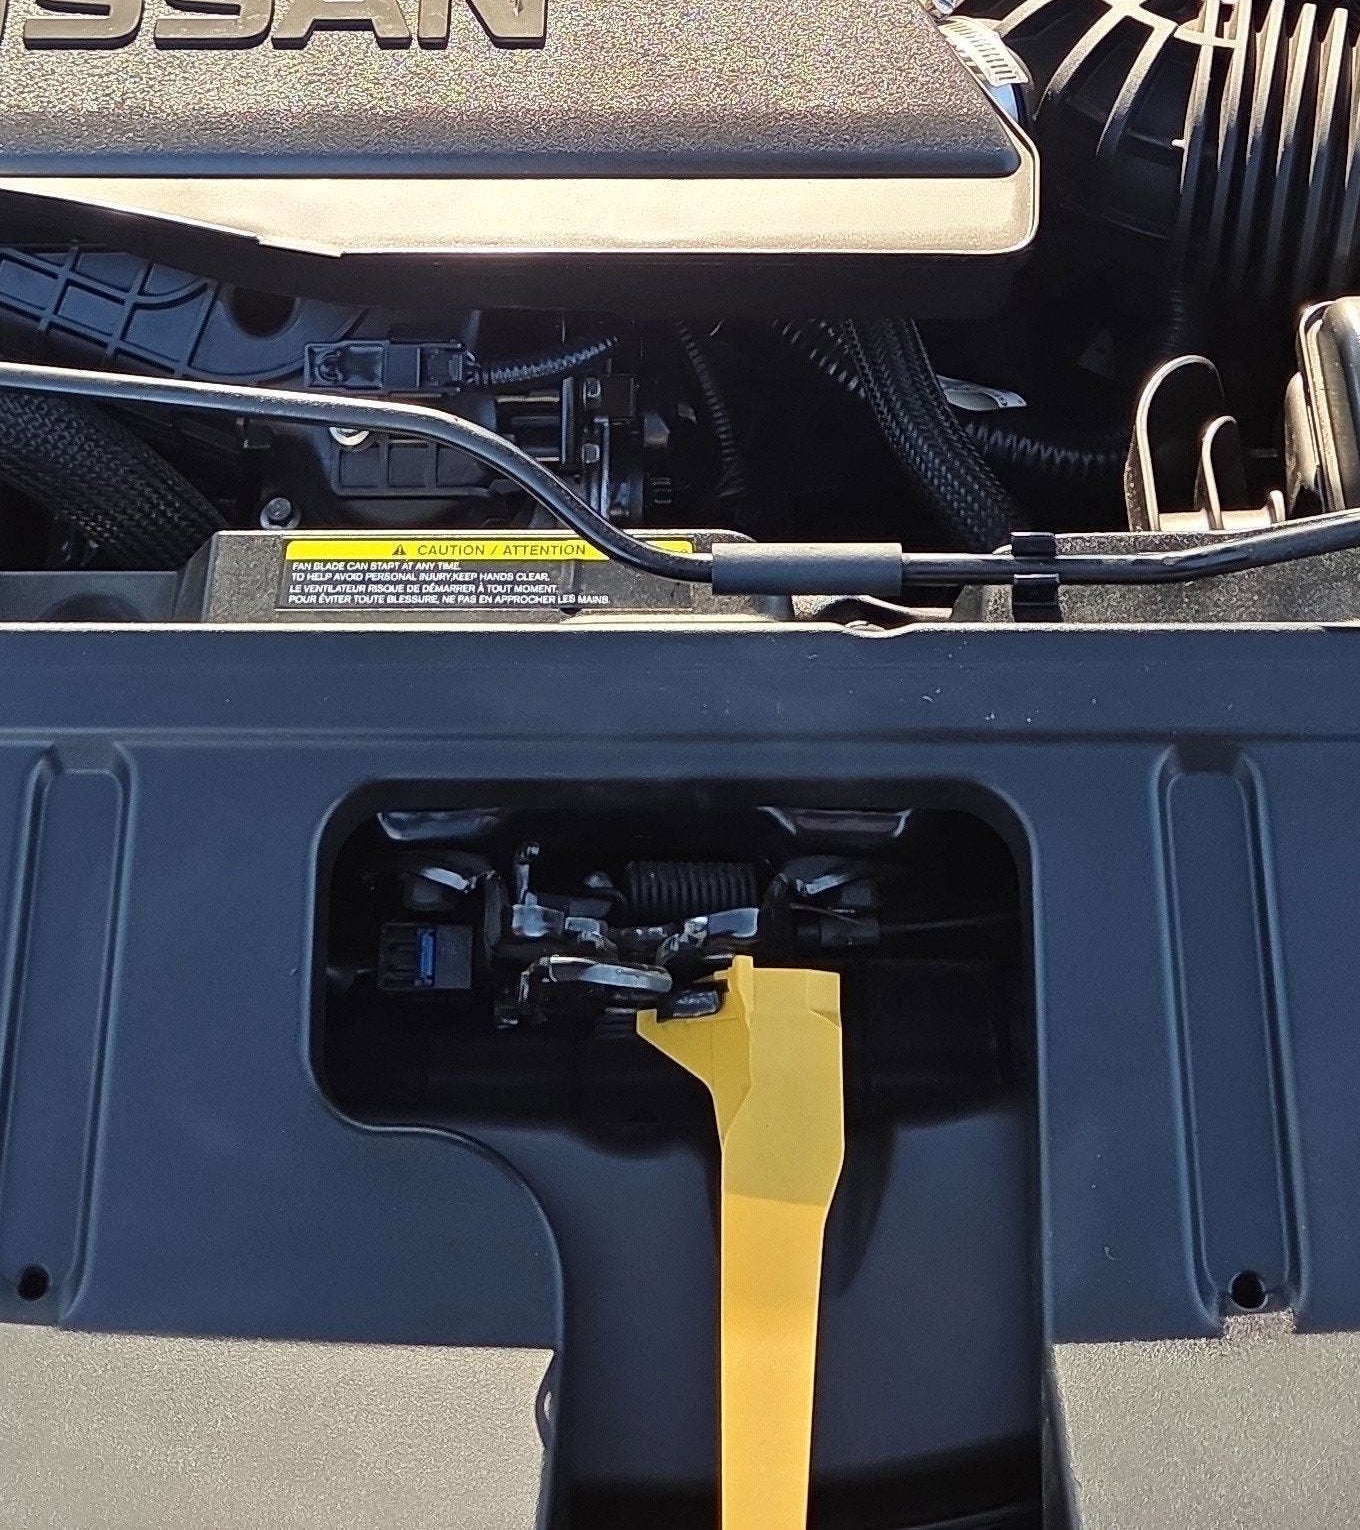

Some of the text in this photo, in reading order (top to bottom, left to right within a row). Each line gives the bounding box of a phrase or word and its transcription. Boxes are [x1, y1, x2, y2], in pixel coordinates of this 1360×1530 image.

[417, 544, 485, 556] CAUTION
[502, 544, 587, 556] ATTENTION
[292, 561, 311, 570] FAN
[313, 561, 345, 570] BLADE
[347, 561, 369, 570] CAN
[370, 561, 400, 570] START
[401, 561, 413, 570] AT
[415, 561, 436, 570] ANY
[292, 572, 304, 581] TO
[307, 572, 332, 581] HELP
[333, 572, 363, 581] AVOID
[365, 572, 417, 581] PERSONAL
[480, 572, 514, 581] HANDS
[289, 584, 301, 593] LE
[304, 584, 366, 593] VENTILATEUR
[406, 584, 420, 593] DE
[486, 584, 513, 593] TOUT
[288, 595, 318, 604] POUR
[353, 595, 385, 604] TOUTE
[442, 595, 456, 604] NE
[457, 595, 477, 604] PAS
[479, 595, 493, 604] EN
[494, 595, 556, 604] APPROCHER
[558, 595, 575, 604] LES
